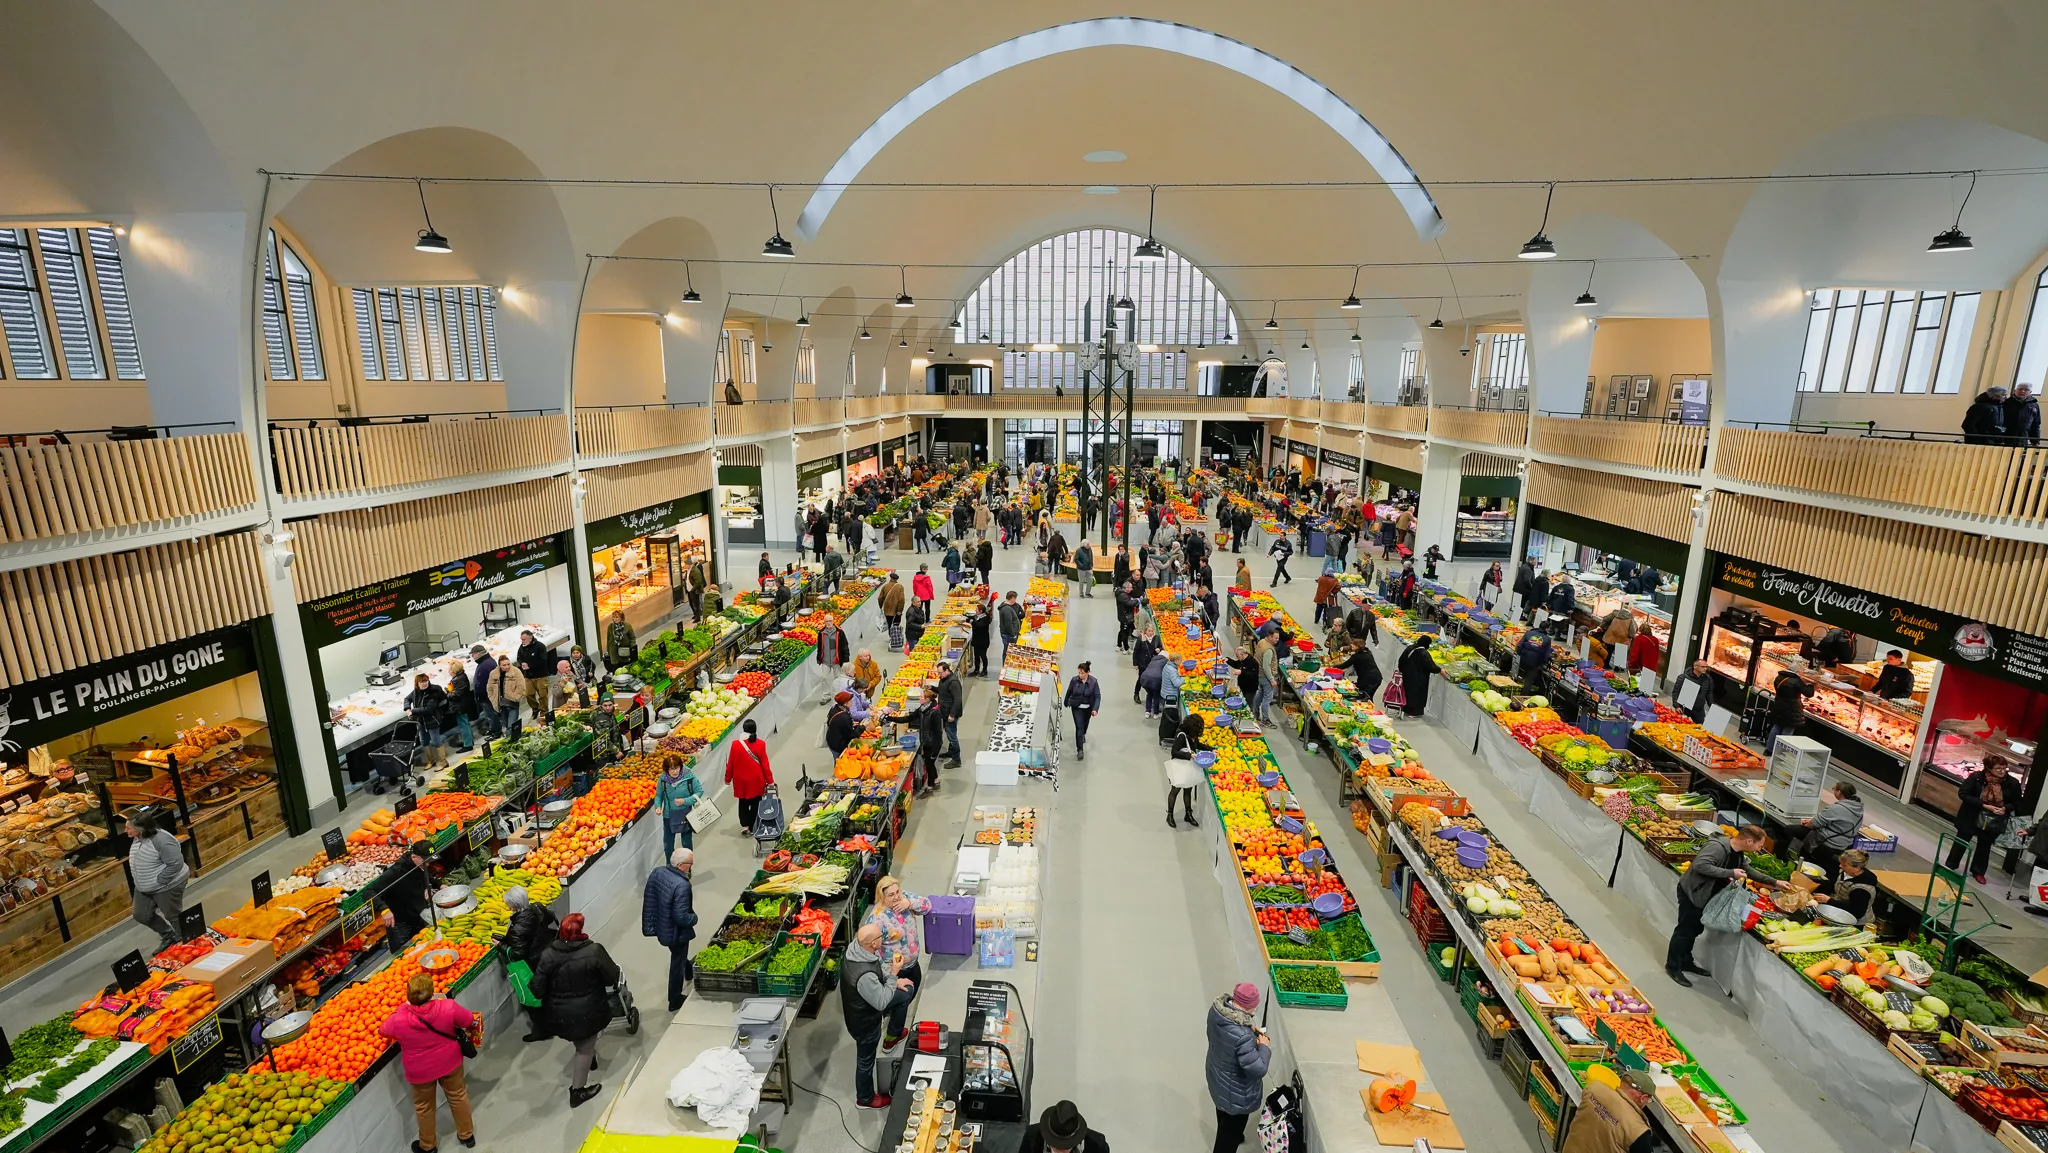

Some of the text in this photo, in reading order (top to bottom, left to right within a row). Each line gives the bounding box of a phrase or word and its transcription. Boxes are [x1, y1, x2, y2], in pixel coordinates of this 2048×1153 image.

[1723, 573, 1755, 589] de volailles
[406, 571, 506, 615] Poissonnerie La Mostelle
[1761, 569, 1883, 619] la Ferme des Alouettes
[327, 606, 355, 619] Plateaux
[363, 598, 379, 608] fruits
[334, 602, 396, 626] Saumon fumé Maison
[1889, 607, 1940, 631] Producteur
[1955, 644, 1987, 655] DIENNET
[2011, 649, 2042, 663] Volailles
[2007, 665, 2043, 681] Rôtisserie
[2009, 657, 2026, 669] Plats
[32, 641, 225, 721] LE PAIN DU GONE
[93, 676, 187, 712] BOULANGER-PAYSAN
